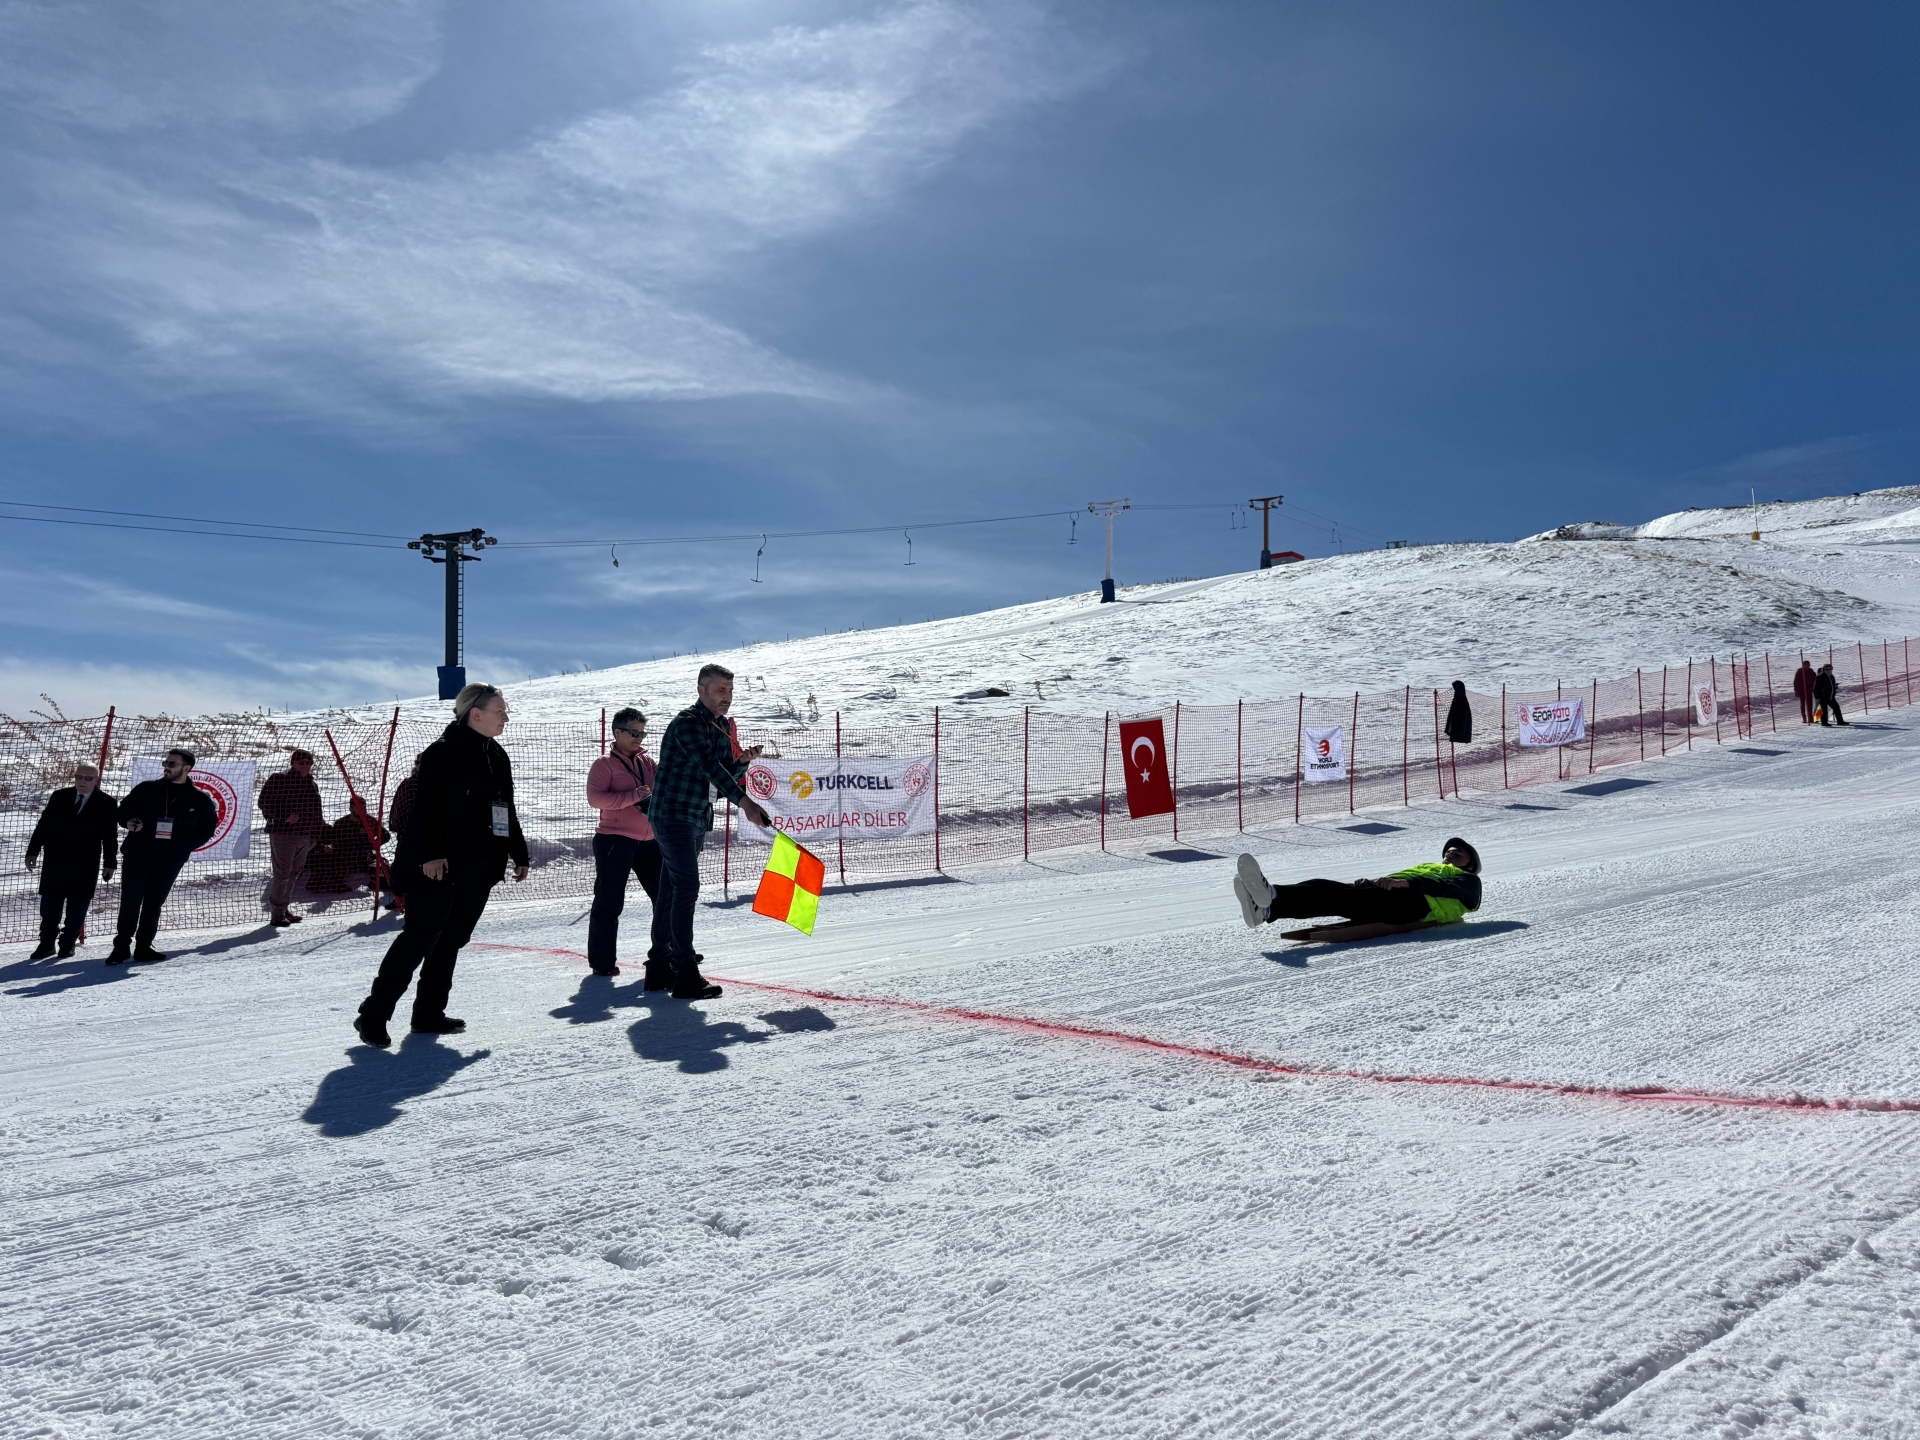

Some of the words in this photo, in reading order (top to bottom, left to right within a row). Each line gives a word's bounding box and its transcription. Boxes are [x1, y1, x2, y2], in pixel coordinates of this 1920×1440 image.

[815, 774, 894, 791] TURKCELL
[773, 812, 861, 834] BAŞARILAR
[864, 809, 908, 827] DİLER
